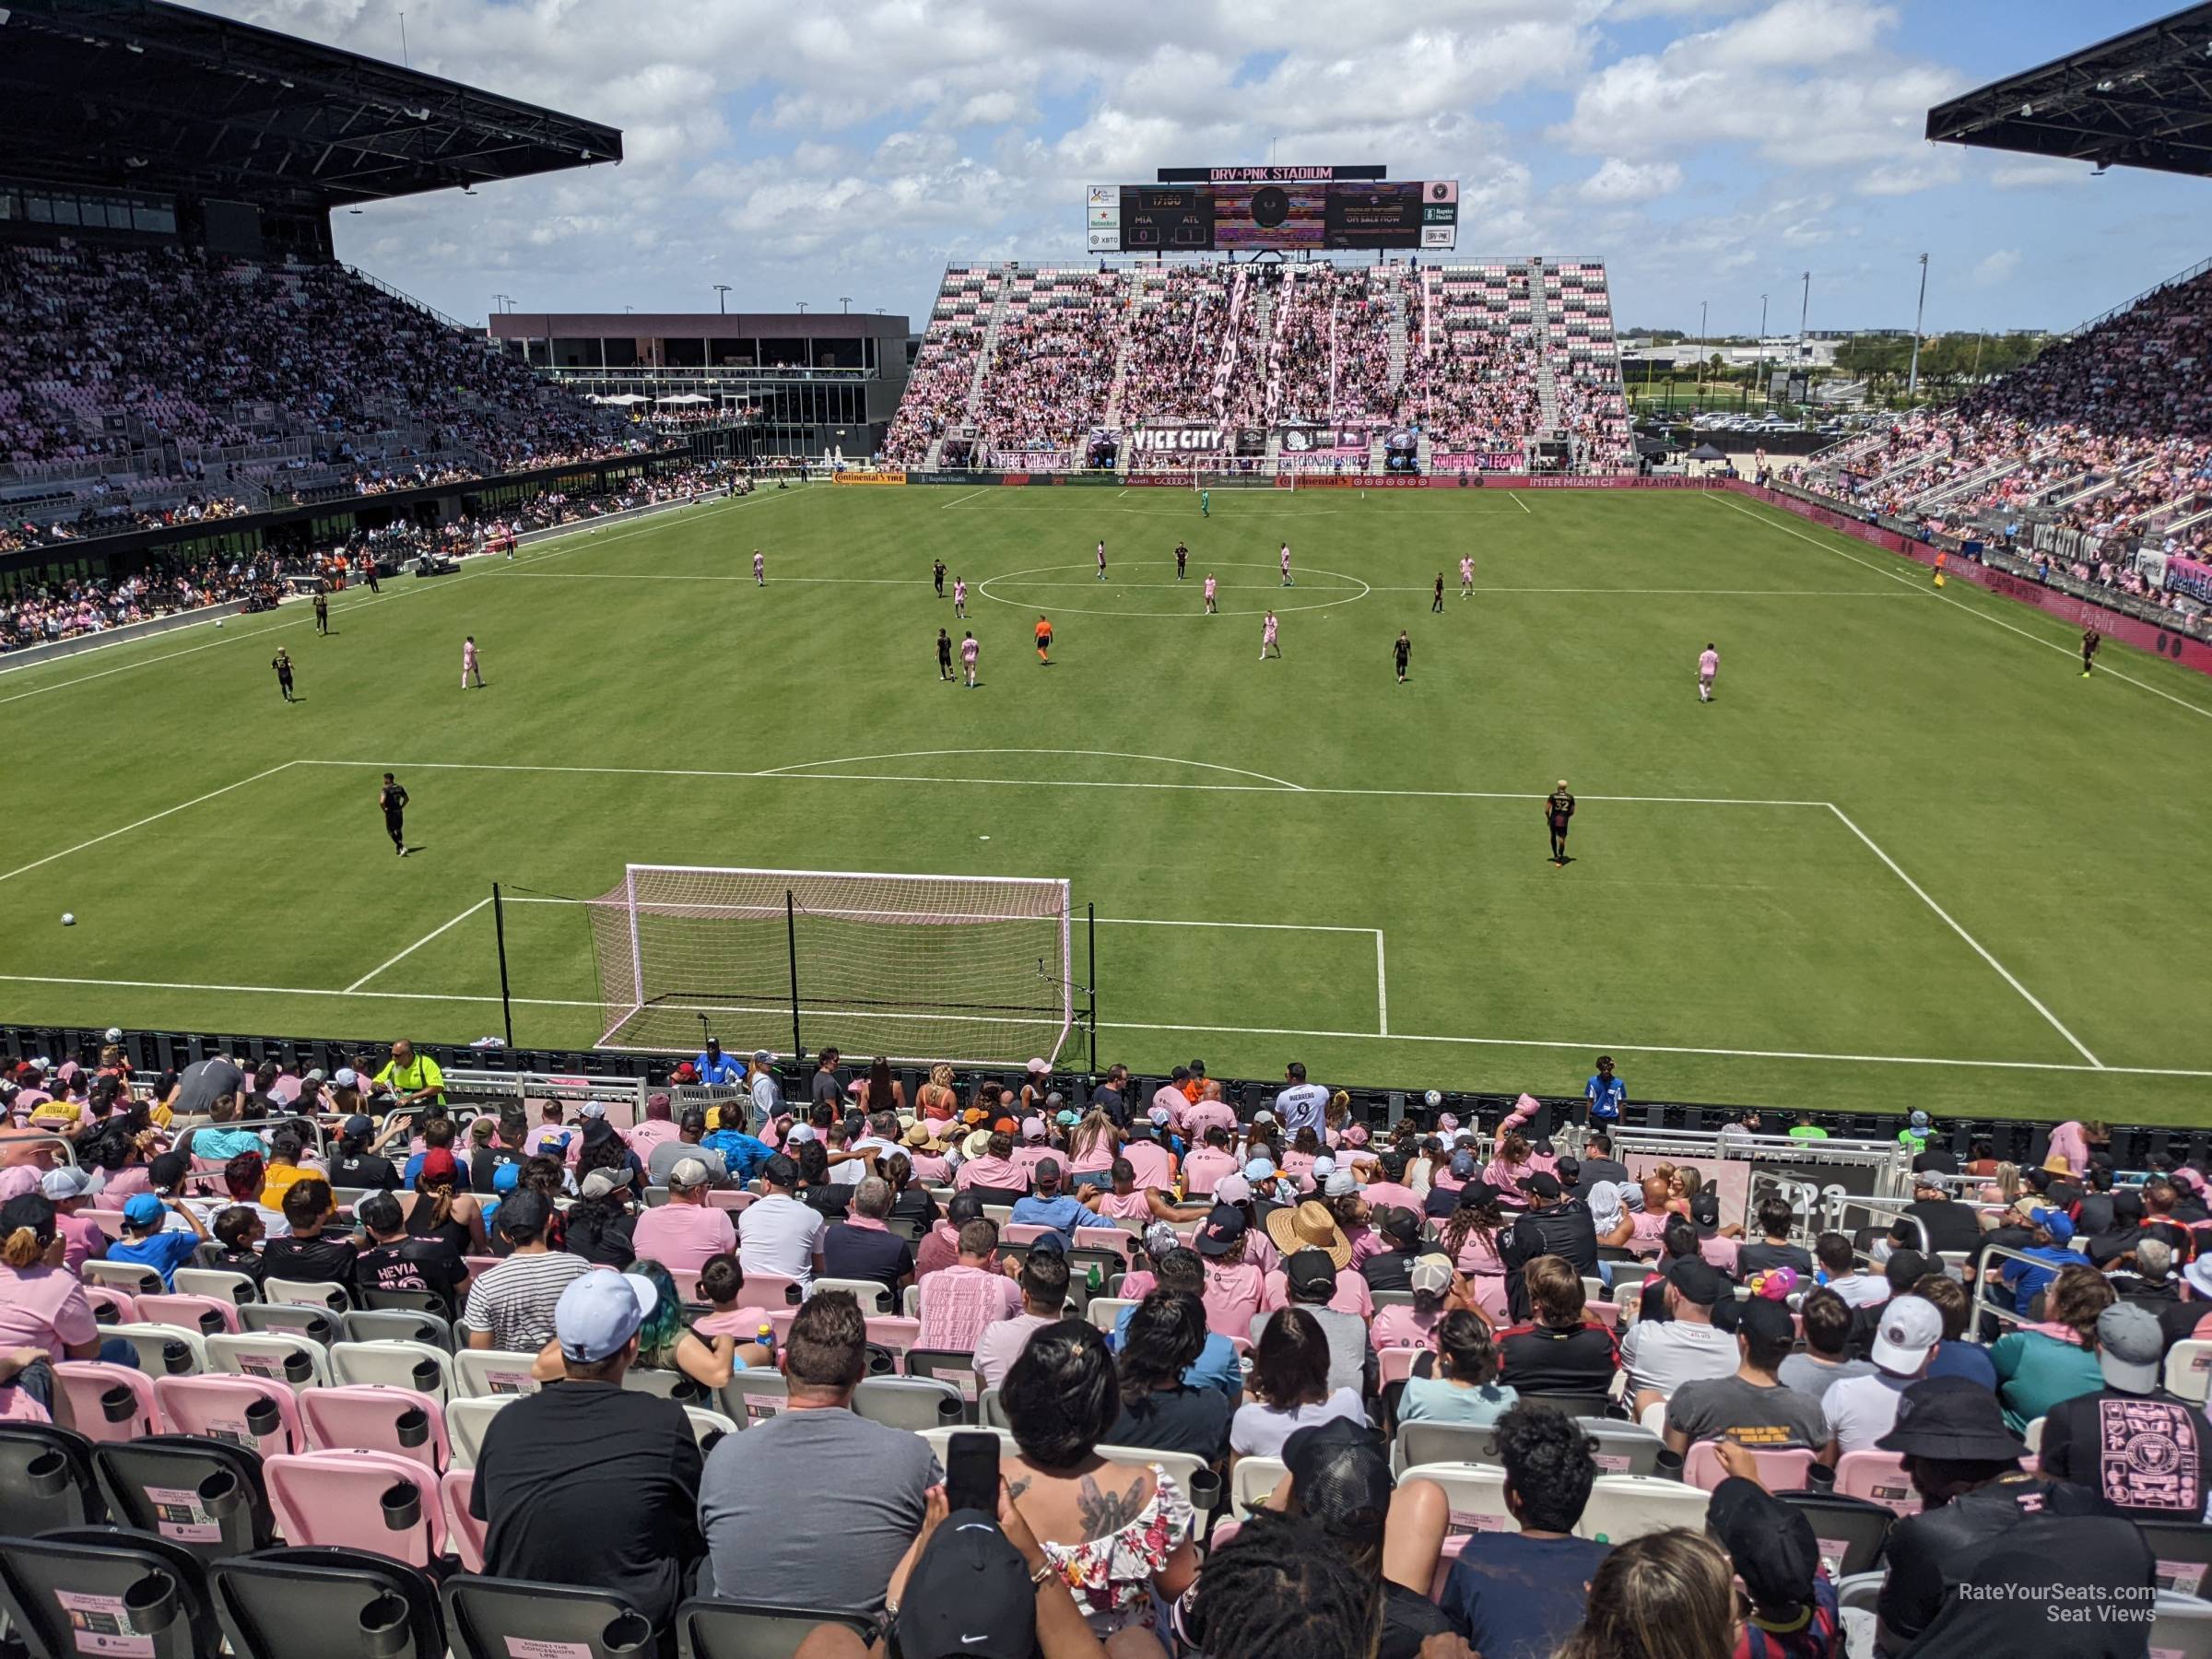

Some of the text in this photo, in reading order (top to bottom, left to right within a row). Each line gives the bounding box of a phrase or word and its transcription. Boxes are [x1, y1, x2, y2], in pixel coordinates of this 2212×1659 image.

[1273, 167, 1333, 180] STADIUM
[1135, 216, 1153, 224] MIA
[1182, 216, 1199, 224] ATL
[1139, 229, 1147, 241] 0
[1243, 263, 1265, 274] CITY
[1276, 262, 1325, 274] PRESENTE
[113, 418, 124, 427] 101
[1134, 429, 1223, 451] VICE CITY
[1026, 453, 1059, 468] MIAMI
[1342, 454, 1359, 467] SUR
[1432, 453, 1523, 469] SOUTHERN LEGION
[835, 472, 878, 483] Continental
[1530, 478, 1615, 487] INTER MIAMI CF
[1631, 478, 1725, 488] ATLANTA UNITED
[1555, 799, 1569, 811] 32
[1297, 1101, 1310, 1122] 9
[1775, 1182, 1847, 1217] 123
[377, 1261, 419, 1280] HEVIA
